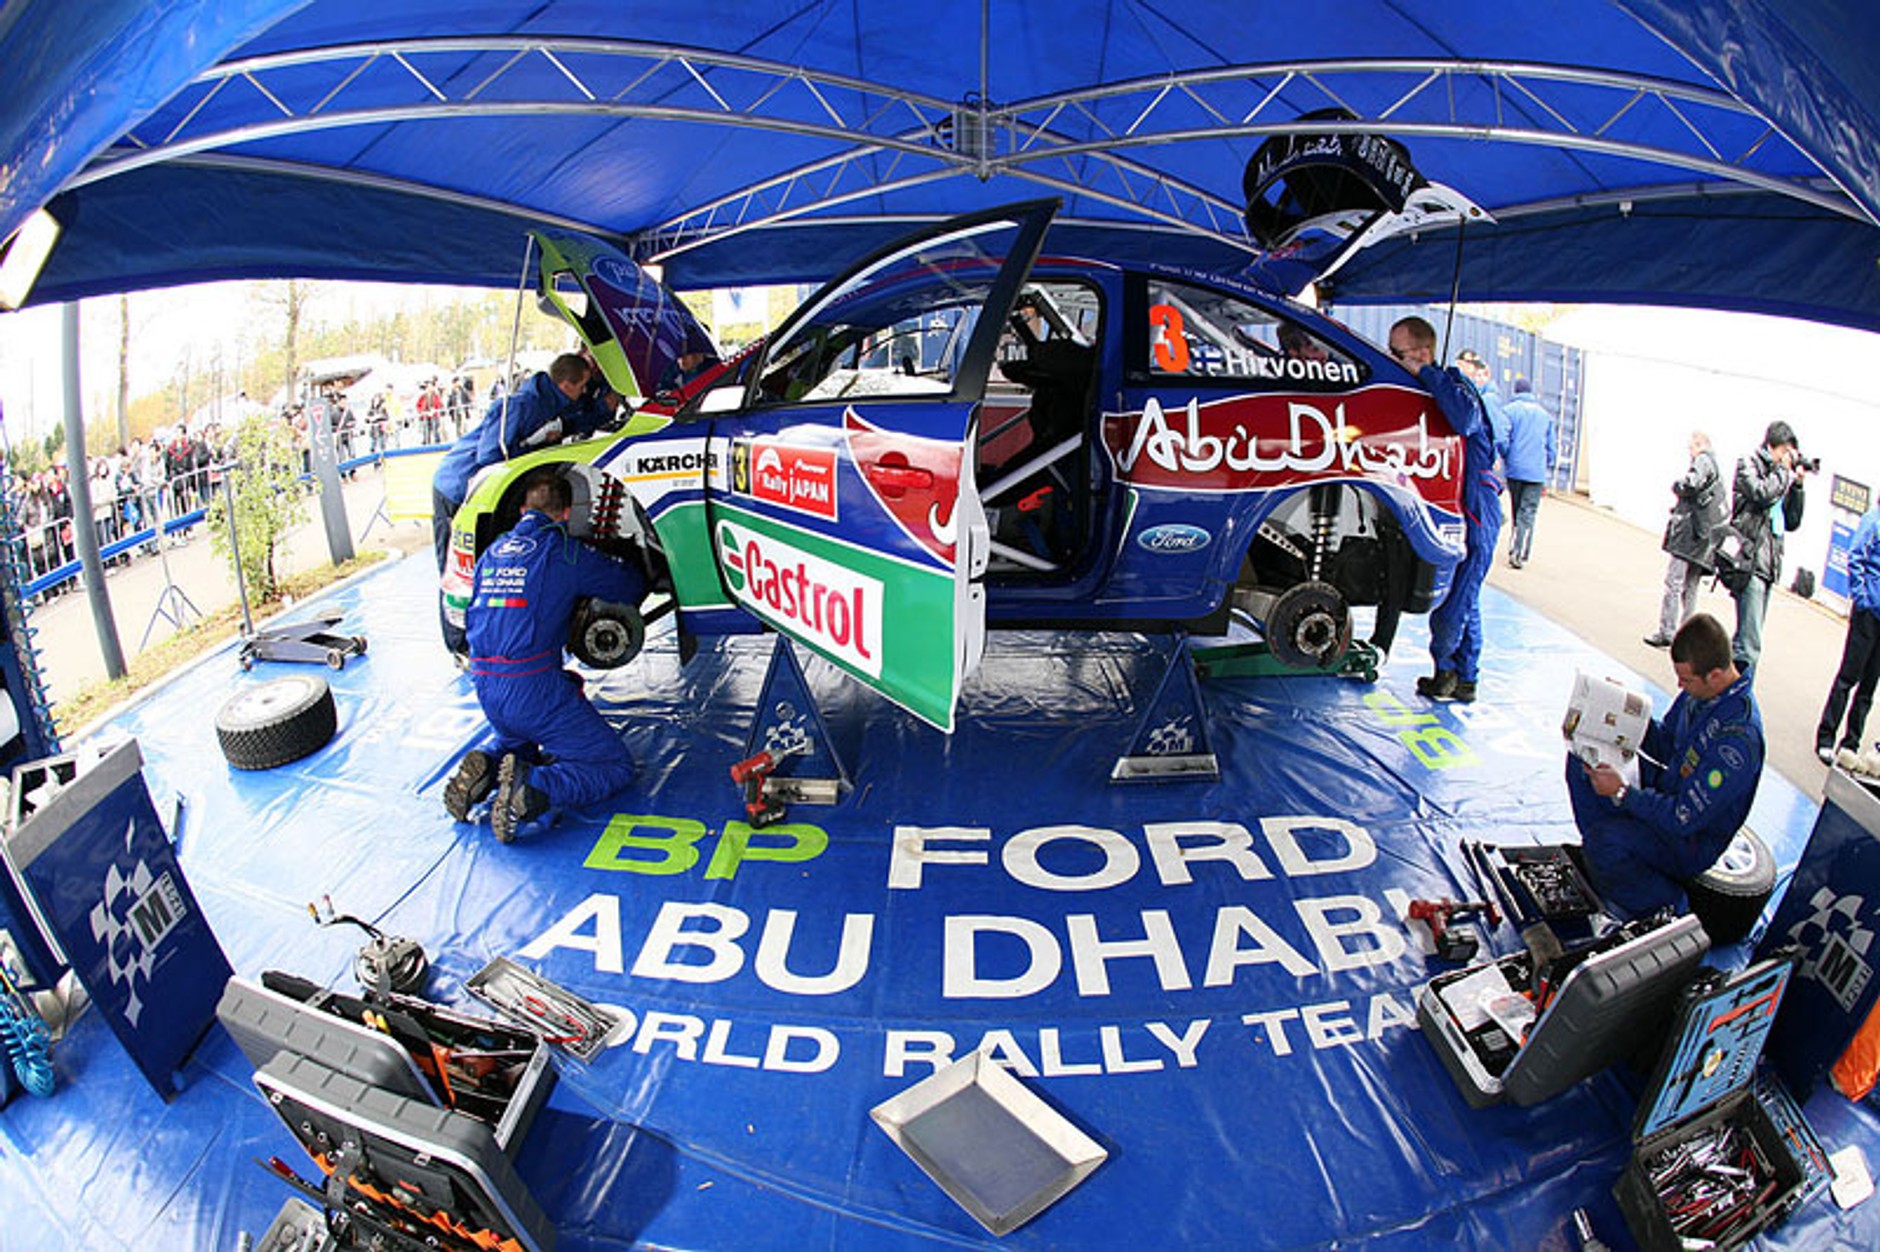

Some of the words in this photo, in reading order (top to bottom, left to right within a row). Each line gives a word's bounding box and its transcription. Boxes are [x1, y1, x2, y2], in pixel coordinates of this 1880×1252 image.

[1149, 303, 1191, 373] 3
[1225, 346, 1360, 384] Hirvonen
[734, 445, 748, 491] 3
[1148, 529, 1198, 550] Ford
[744, 539, 872, 660] Castrol
[583, 814, 829, 880] BP
[888, 815, 1379, 891] FORD
[518, 893, 876, 996] ABU
[943, 888, 1439, 998] DHABI
[883, 1019, 1212, 1077] RALLY
[1243, 984, 1426, 1056] TEA
